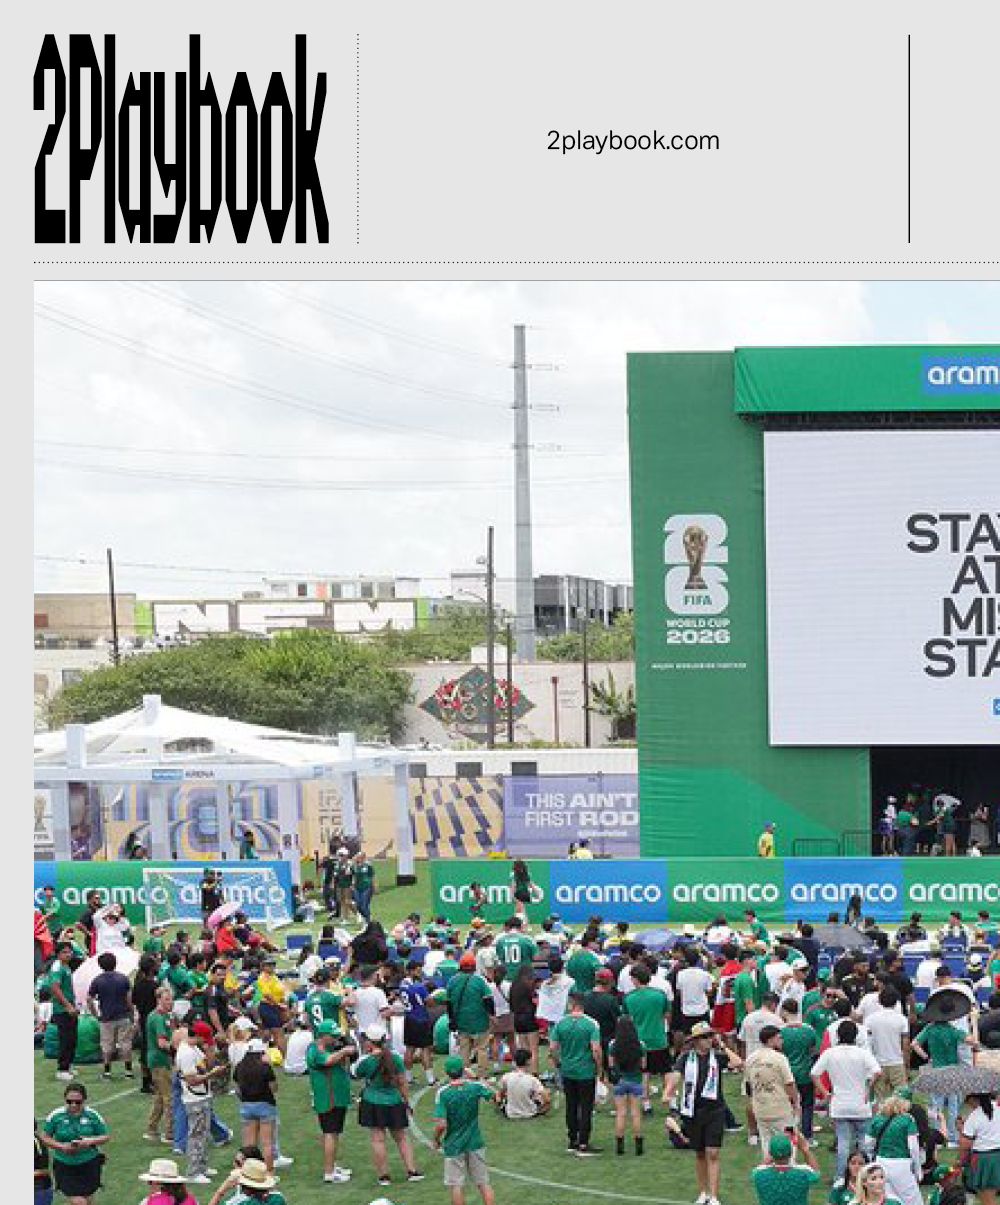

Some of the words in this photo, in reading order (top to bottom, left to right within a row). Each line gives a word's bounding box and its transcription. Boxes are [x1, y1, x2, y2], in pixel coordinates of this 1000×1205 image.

[684, 595, 712, 605] FIFA
[666, 629, 730, 644] 2026
[525, 793, 566, 808] THIS
[525, 811, 574, 828] FIRST
[555, 882, 662, 903] aramco
[672, 882, 781, 903] aramco
[790, 881, 898, 903] aramco
[504, 943, 521, 963] 10
